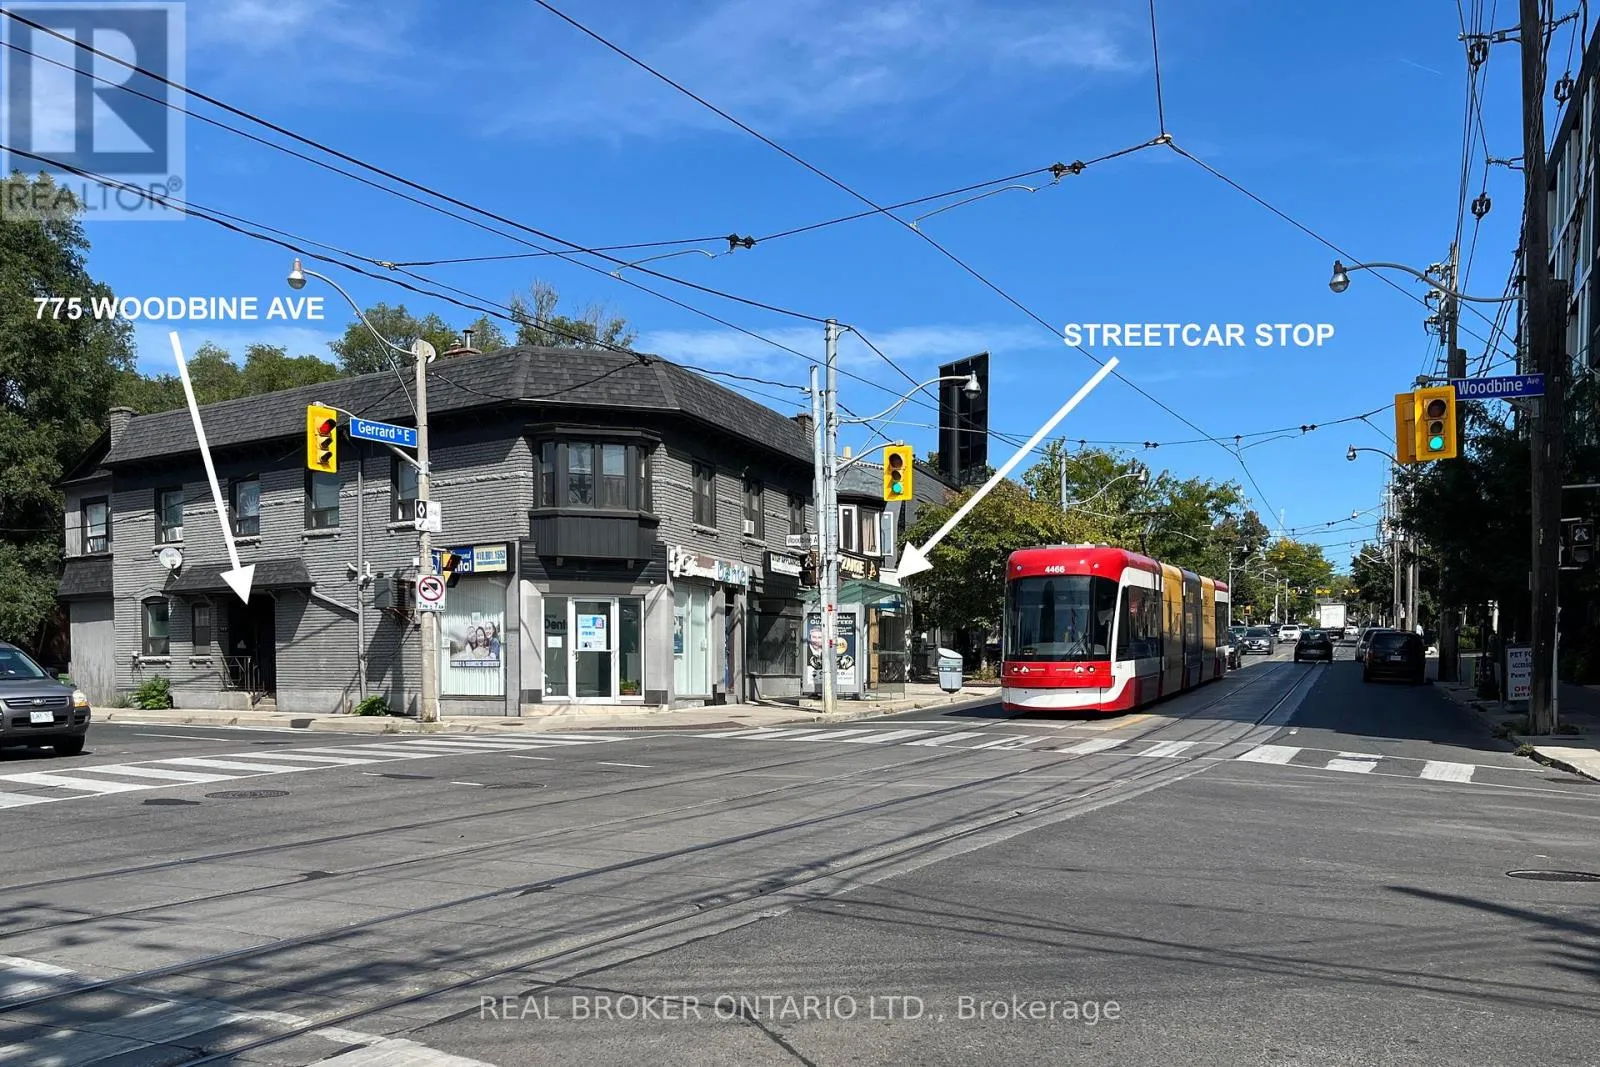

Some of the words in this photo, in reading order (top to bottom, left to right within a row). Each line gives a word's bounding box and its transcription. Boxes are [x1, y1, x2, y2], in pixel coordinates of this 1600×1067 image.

[1457, 379, 1524, 396] Woodbine
[1526, 377, 1540, 386] Ave
[357, 421, 396, 439] Gerrard
[404, 430, 410, 441] E
[1045, 565, 1065, 573] 4466
